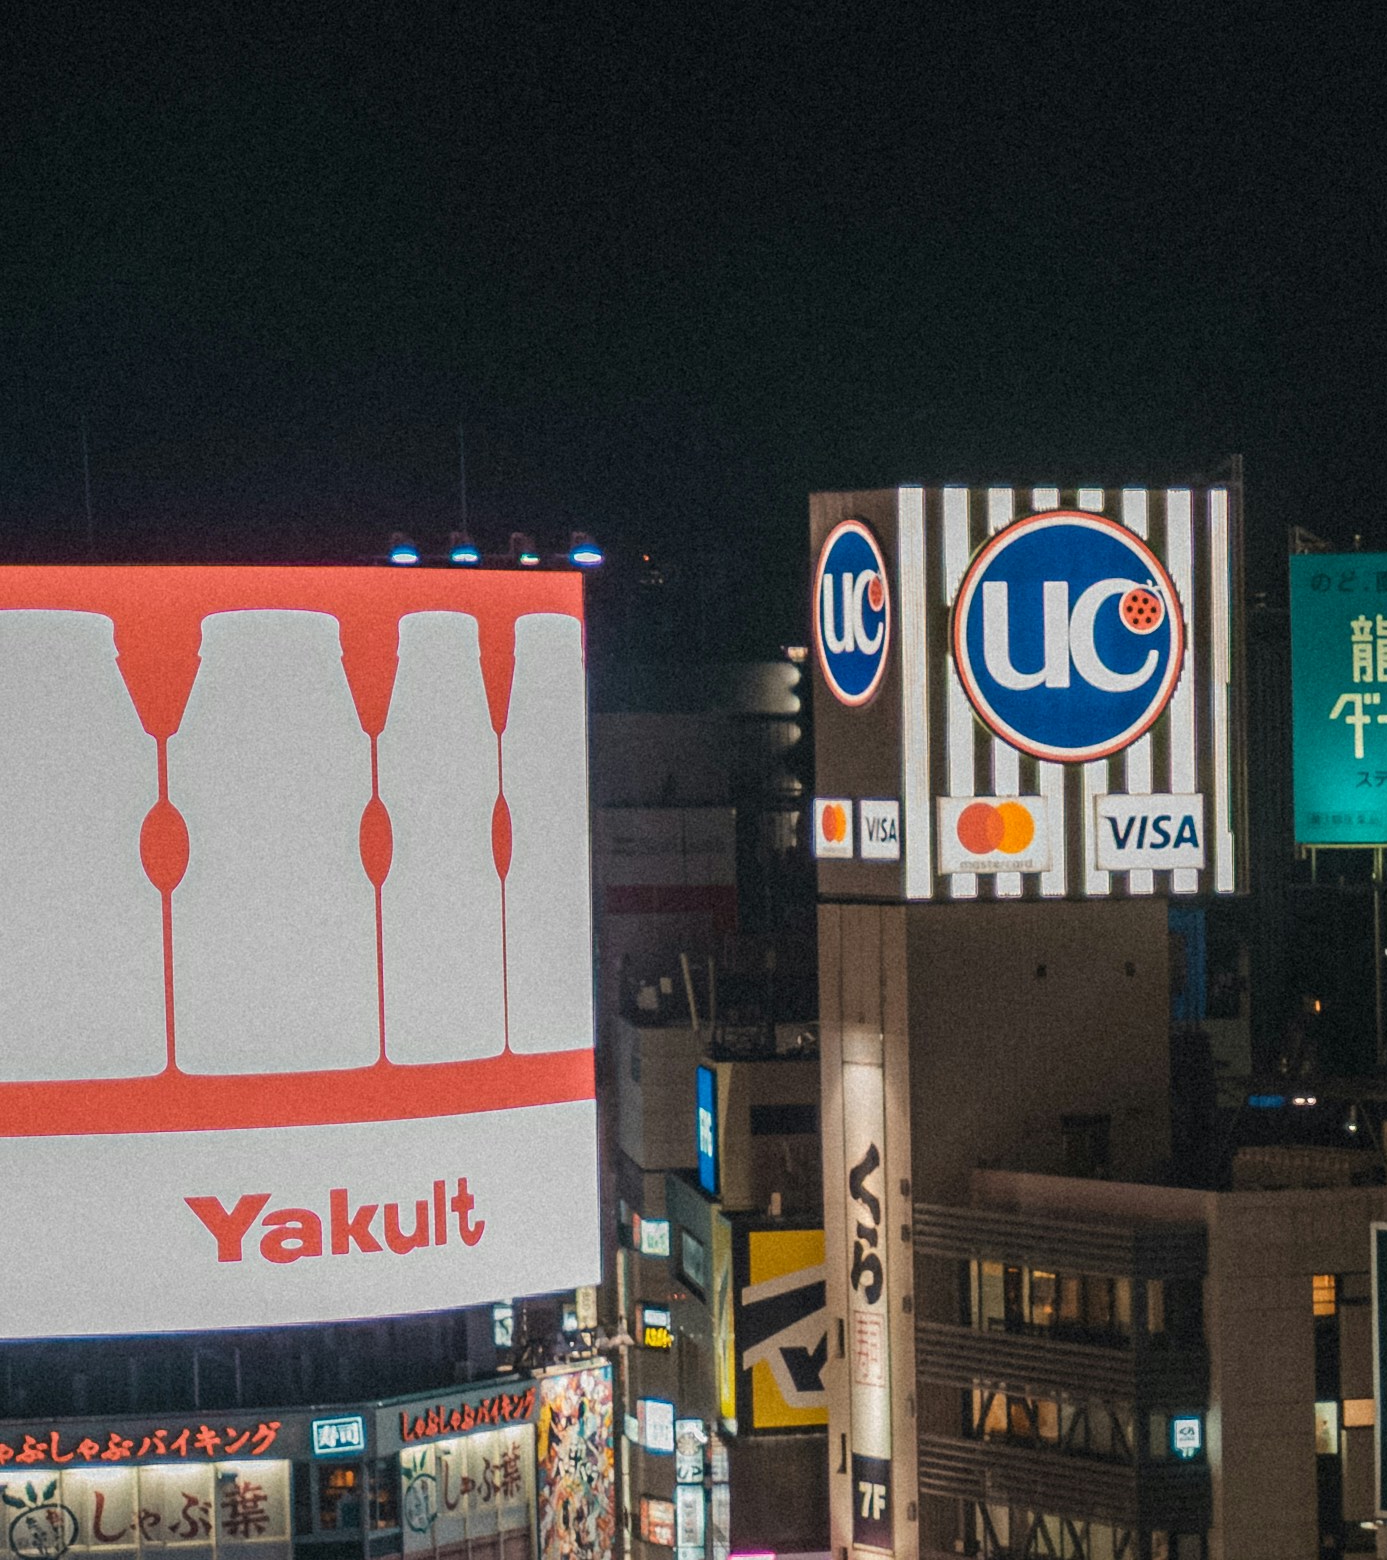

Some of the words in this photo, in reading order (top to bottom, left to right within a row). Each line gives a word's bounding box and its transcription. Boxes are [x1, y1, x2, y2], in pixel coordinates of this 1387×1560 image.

[865, 817, 897, 842] VISA
[1104, 814, 1200, 851] VISA
[185, 1177, 486, 1265] Yakult
[401, 1387, 536, 1442] しゃぶしゃぶバイキング
[440, 1436, 522, 1511] しゃぶ葉
[859, 1481, 886, 1520] 7F
[94, 1482, 270, 1541] しゃぶ葉
